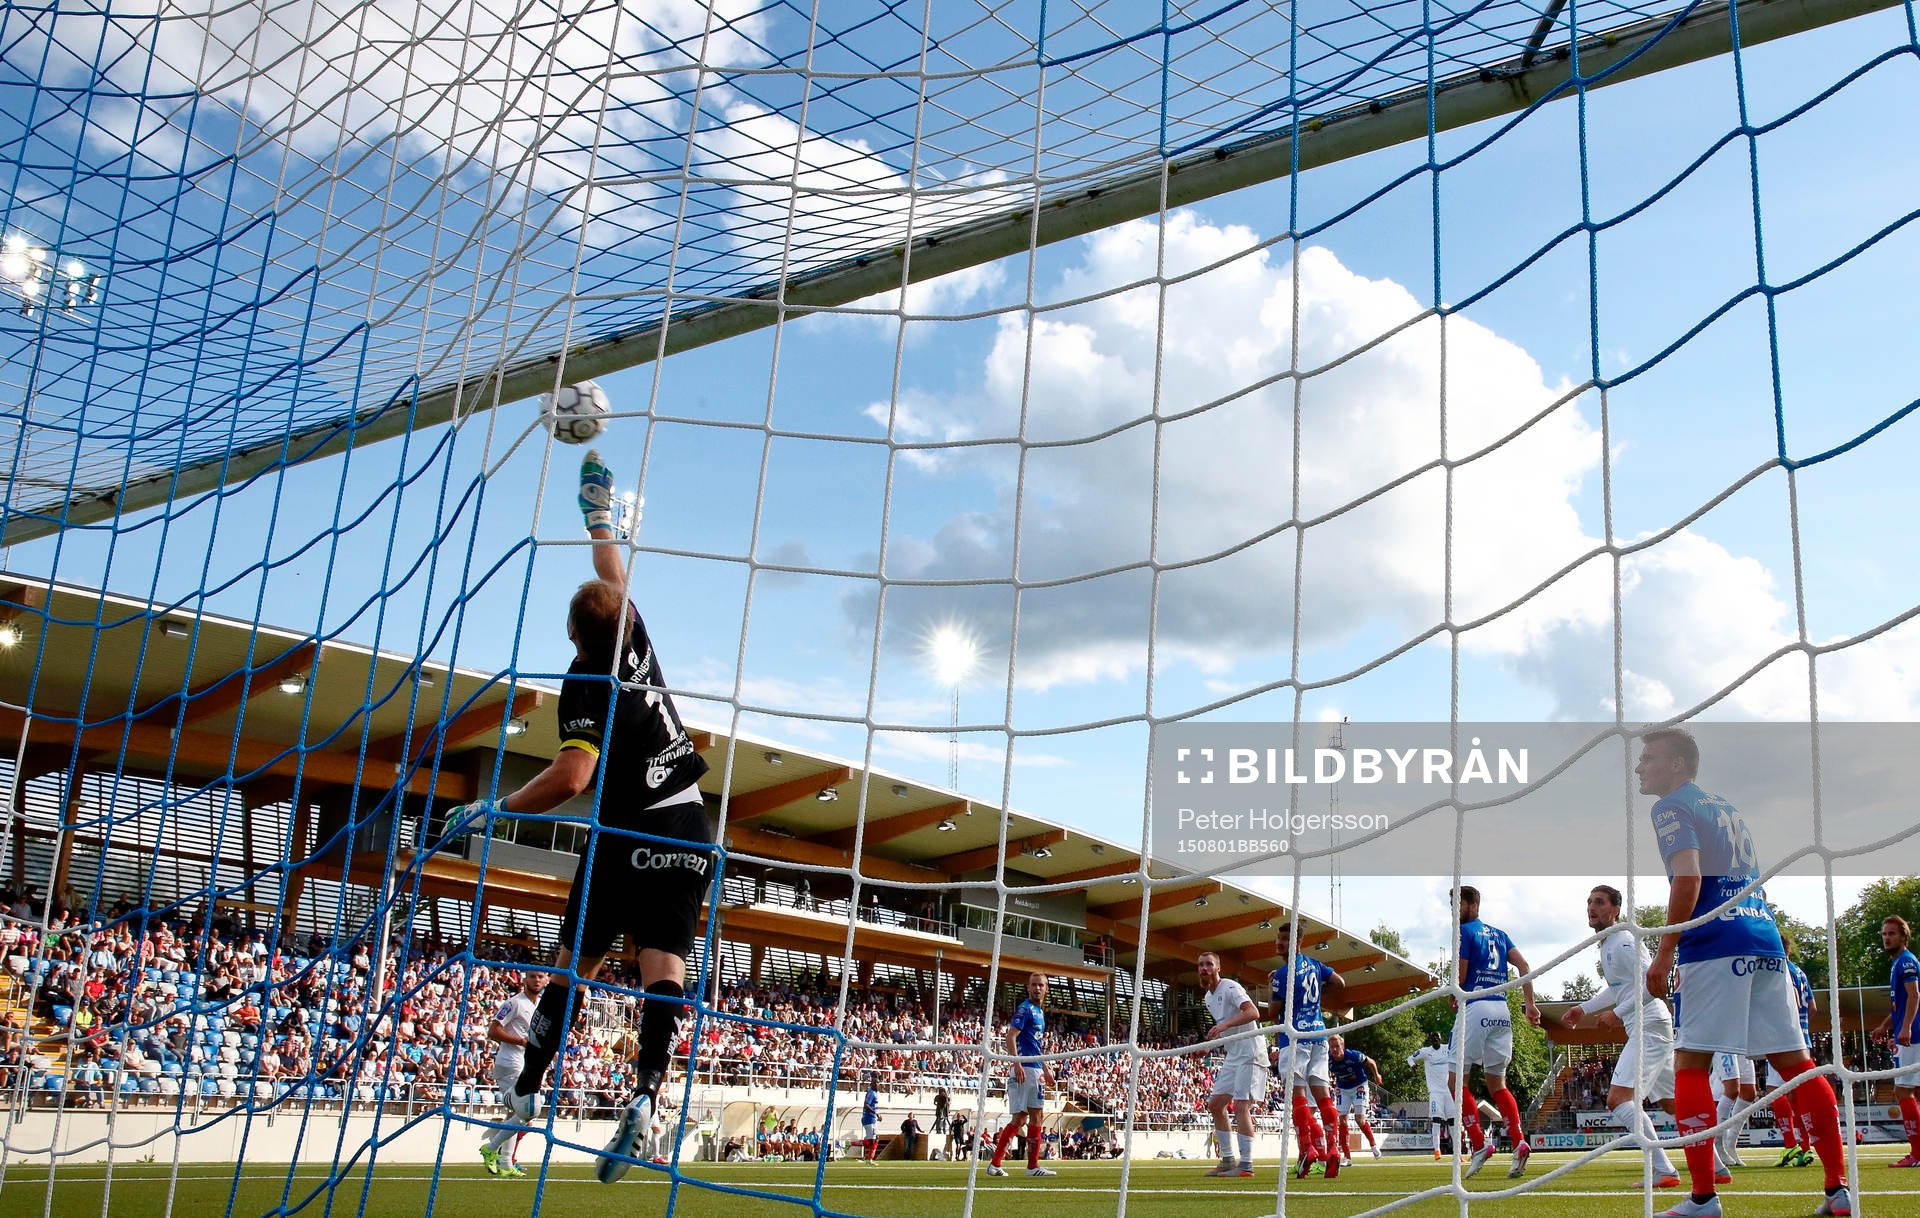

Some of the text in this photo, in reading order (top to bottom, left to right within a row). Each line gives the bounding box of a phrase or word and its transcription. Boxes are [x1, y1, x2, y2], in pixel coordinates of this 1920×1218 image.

[631, 848, 708, 876] Corren
[1301, 972, 1320, 1005] 10
[1721, 1054, 1734, 1068] 21
[1584, 1118, 1607, 1126] NCC
[1546, 1135, 1574, 1147] TIPS
